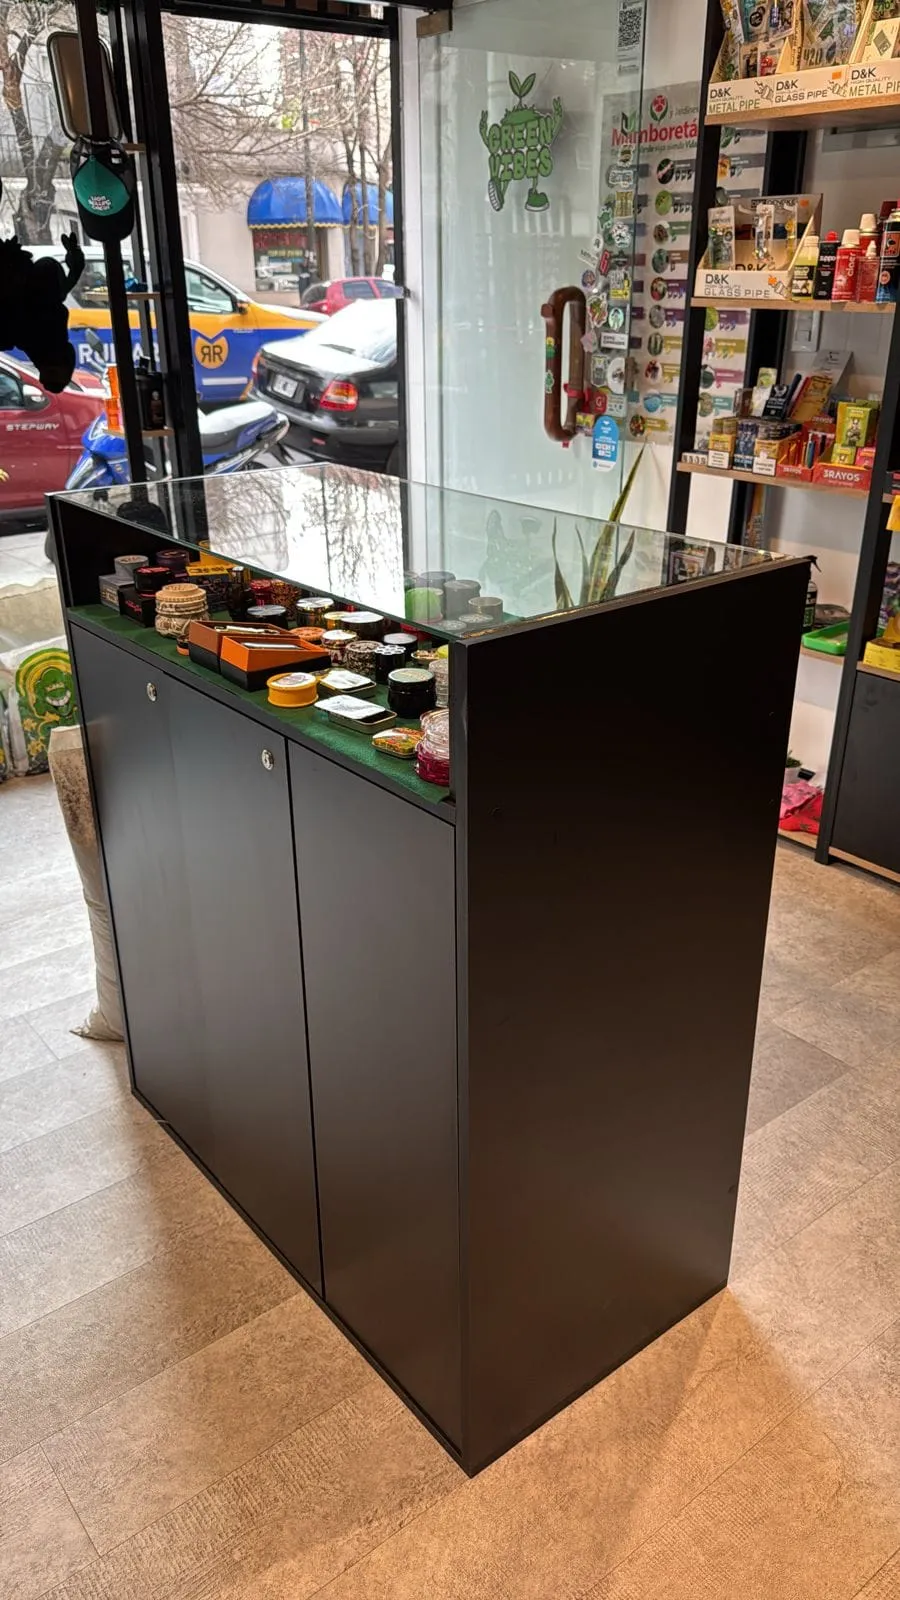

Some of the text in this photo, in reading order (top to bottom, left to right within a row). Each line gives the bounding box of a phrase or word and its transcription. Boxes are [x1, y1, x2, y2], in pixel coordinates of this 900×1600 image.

[851, 67, 877, 81] D&K
[776, 79, 799, 91] D&K
[848, 80, 900, 97] METAL PIP
[710, 87, 732, 99] D&K
[774, 89, 828, 104] GLASS PIPE
[708, 98, 761, 114] METAL PIPE
[488, 115, 554, 154] GREEN
[488, 146, 554, 182] VIBES
[705, 273, 730, 285] D&K
[704, 287, 771, 299] GLASS PIPE
[5, 422, 60, 432] STEPWAY
[822, 468, 861, 482] 3RAYOS
